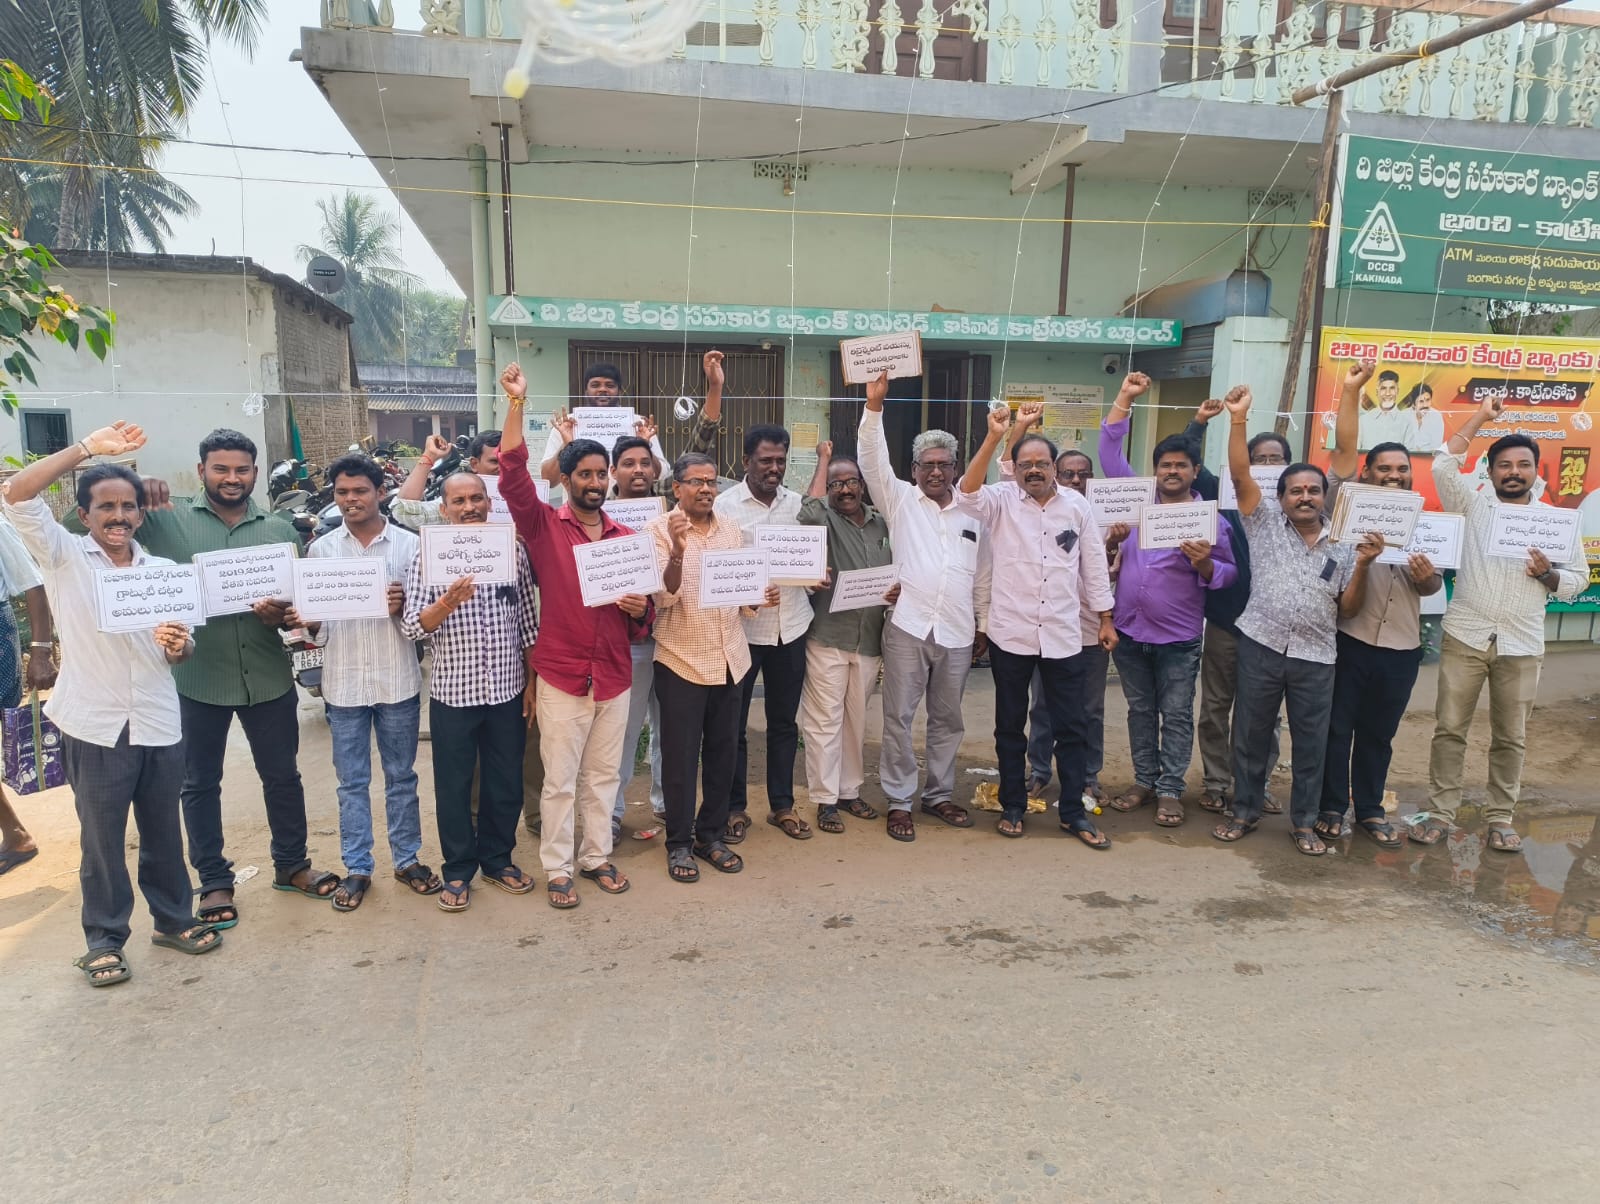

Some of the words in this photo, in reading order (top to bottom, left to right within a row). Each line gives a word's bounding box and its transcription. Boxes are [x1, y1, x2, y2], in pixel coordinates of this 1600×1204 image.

[1356, 156, 1371, 181] ది
[1375, 156, 1414, 191] జిల్లా
[1418, 153, 1461, 199] కేంద్ర
[1465, 161, 1540, 196] సహకార
[1439, 212, 1512, 233] బ్రాంచి
[1445, 248, 1473, 261] ATM
[1367, 261, 1395, 272] DCCB
[1355, 274, 1403, 285] KAKINADA
[620, 300, 679, 330] కేంద్ర
[686, 303, 770, 328] సహకార
[1382, 341, 1469, 363] సహకార
[1472, 343, 1523, 369] కేంద్ర
[1526, 351, 1594, 374] బ్యాంకు
[453, 534, 482, 545] మాకు
[438, 550, 472, 563] ఆరోగ్య
[104, 573, 141, 583] సహకార
[145, 570, 193, 582] ఉద్యోగులకు
[158, 586, 183, 597] చట్టం
[112, 606, 151, 617] అమలు
[153, 602, 195, 614] పరచాలి
